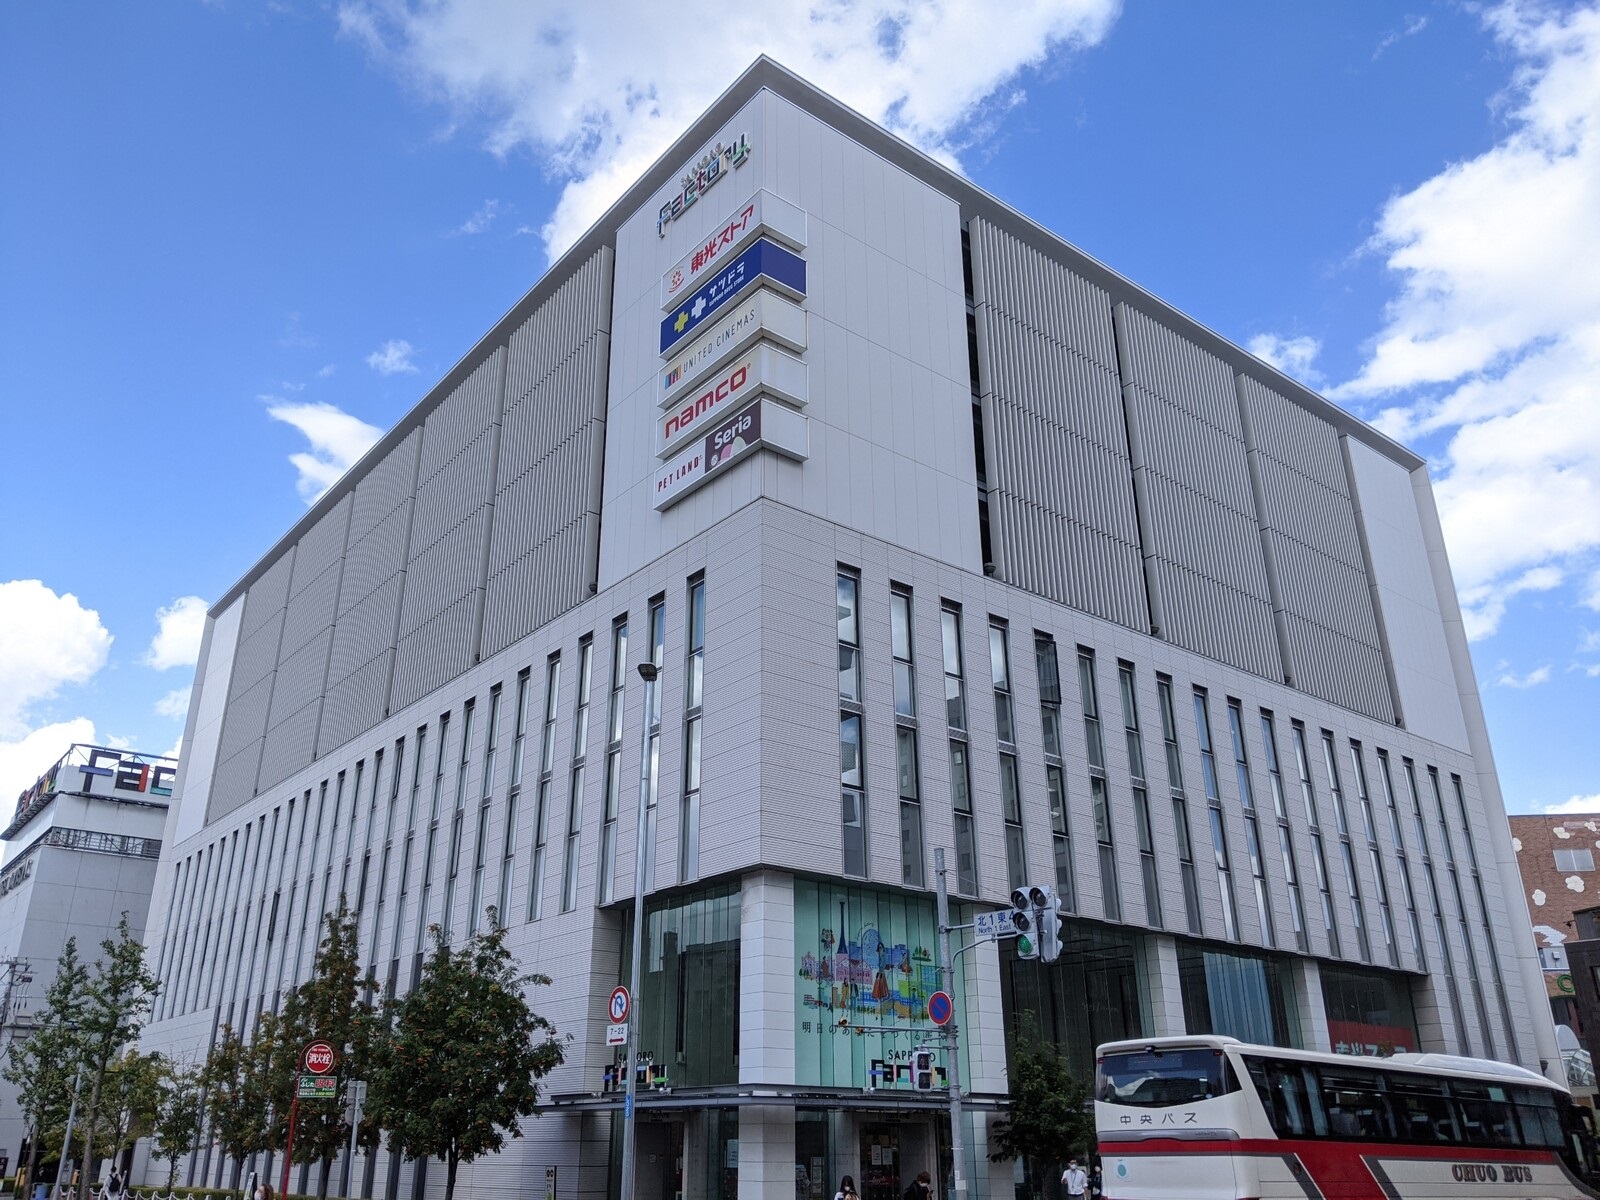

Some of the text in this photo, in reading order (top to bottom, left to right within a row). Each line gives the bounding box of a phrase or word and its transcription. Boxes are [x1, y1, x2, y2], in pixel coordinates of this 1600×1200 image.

[690, 204, 754, 275] 東光ストア
[709, 261, 745, 298] サツドラ
[683, 309, 755, 373] UNITED CINEMAS
[665, 366, 747, 439] namco
[714, 415, 752, 450] Seria
[657, 459, 700, 493] PET LAND
[999, 923, 1012, 932] East
[610, 1026, 624, 1036] 7-22
[308, 1053, 331, 1065] 消火栓
[618, 1051, 653, 1064] SAORO
[888, 1049, 936, 1063] SAPPO
[1119, 1112, 1198, 1125] 中央バス
[1451, 1163, 1533, 1183] CHUO BUS
